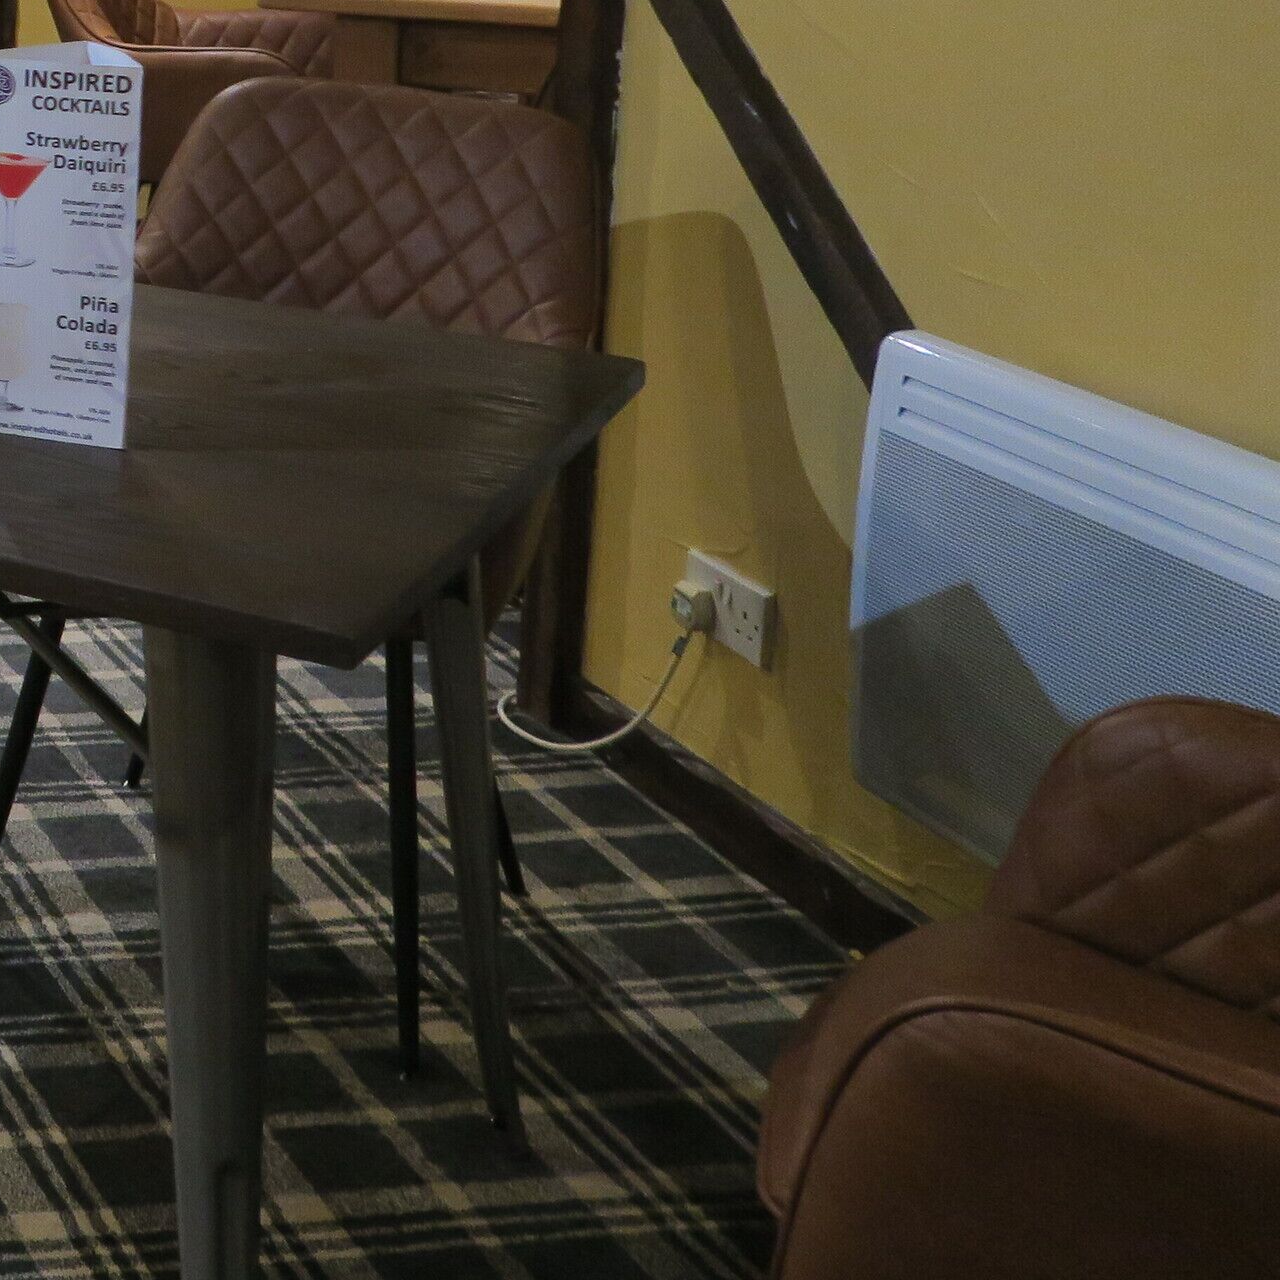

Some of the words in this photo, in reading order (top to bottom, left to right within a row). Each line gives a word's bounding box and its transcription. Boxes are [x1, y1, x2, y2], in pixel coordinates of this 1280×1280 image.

[23, 69, 133, 94] INSPIRED
[32, 95, 130, 116] COCKTAILS
[25, 131, 128, 157] Strawberry
[53, 154, 126, 175] Daiquiri
[91, 181, 125, 193] £6.95
[80, 295, 120, 314] Piña
[56, 315, 118, 336] Colada
[85, 340, 118, 353] £6.95
